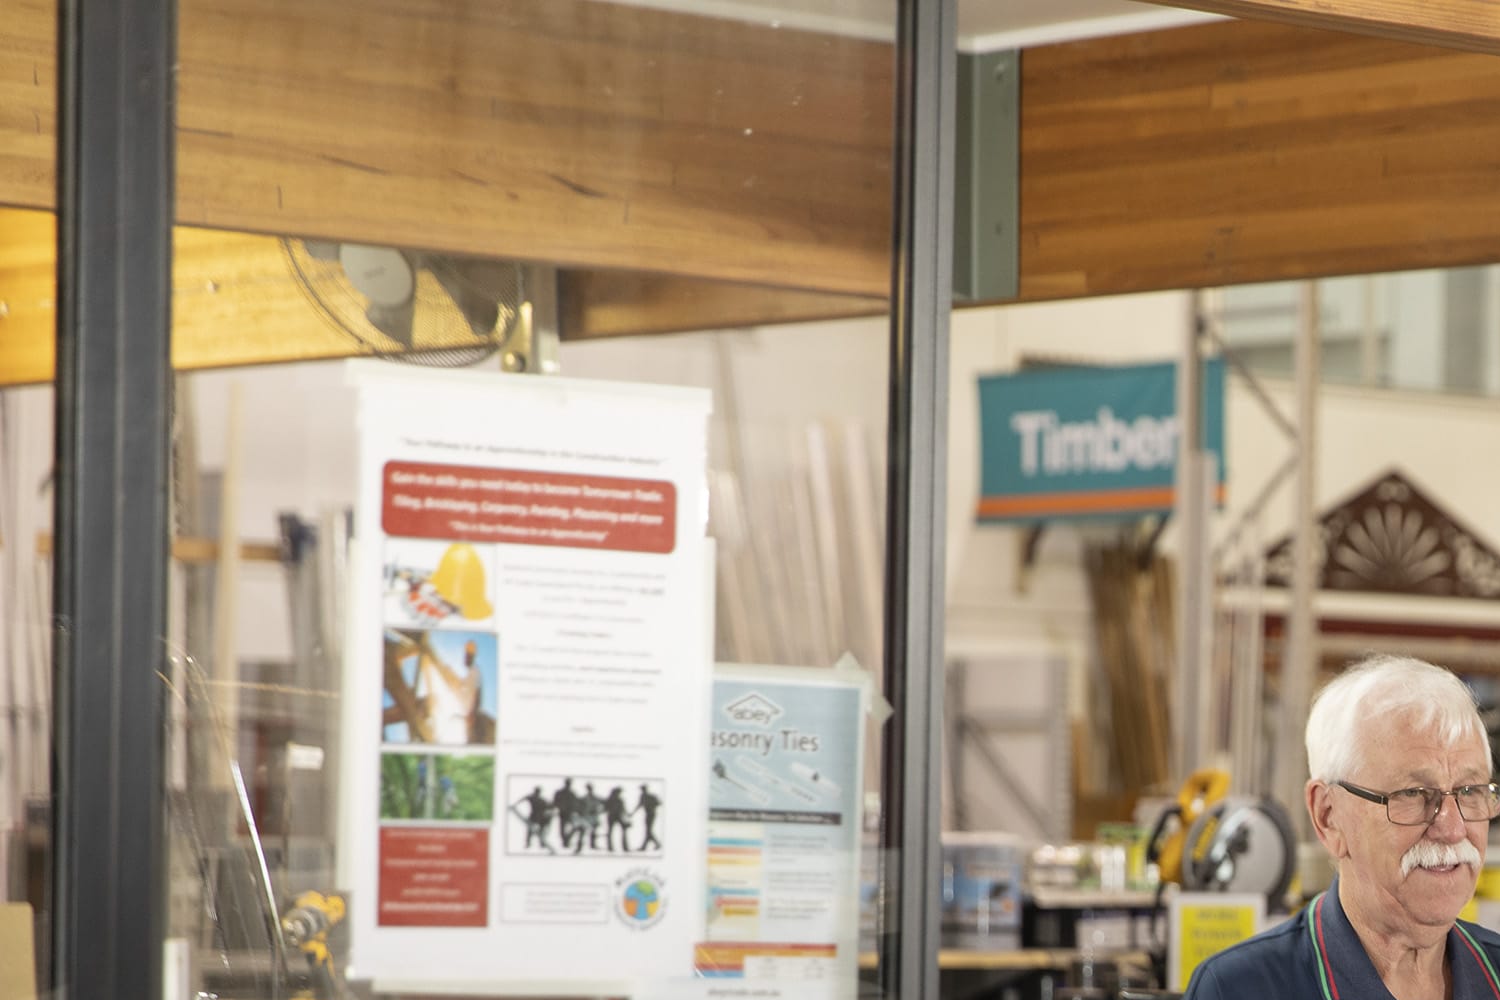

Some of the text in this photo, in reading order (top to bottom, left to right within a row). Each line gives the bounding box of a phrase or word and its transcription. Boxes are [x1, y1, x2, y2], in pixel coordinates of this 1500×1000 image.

[1010, 405, 1178, 475] Timber
[711, 729, 819, 757] sonry Ties
